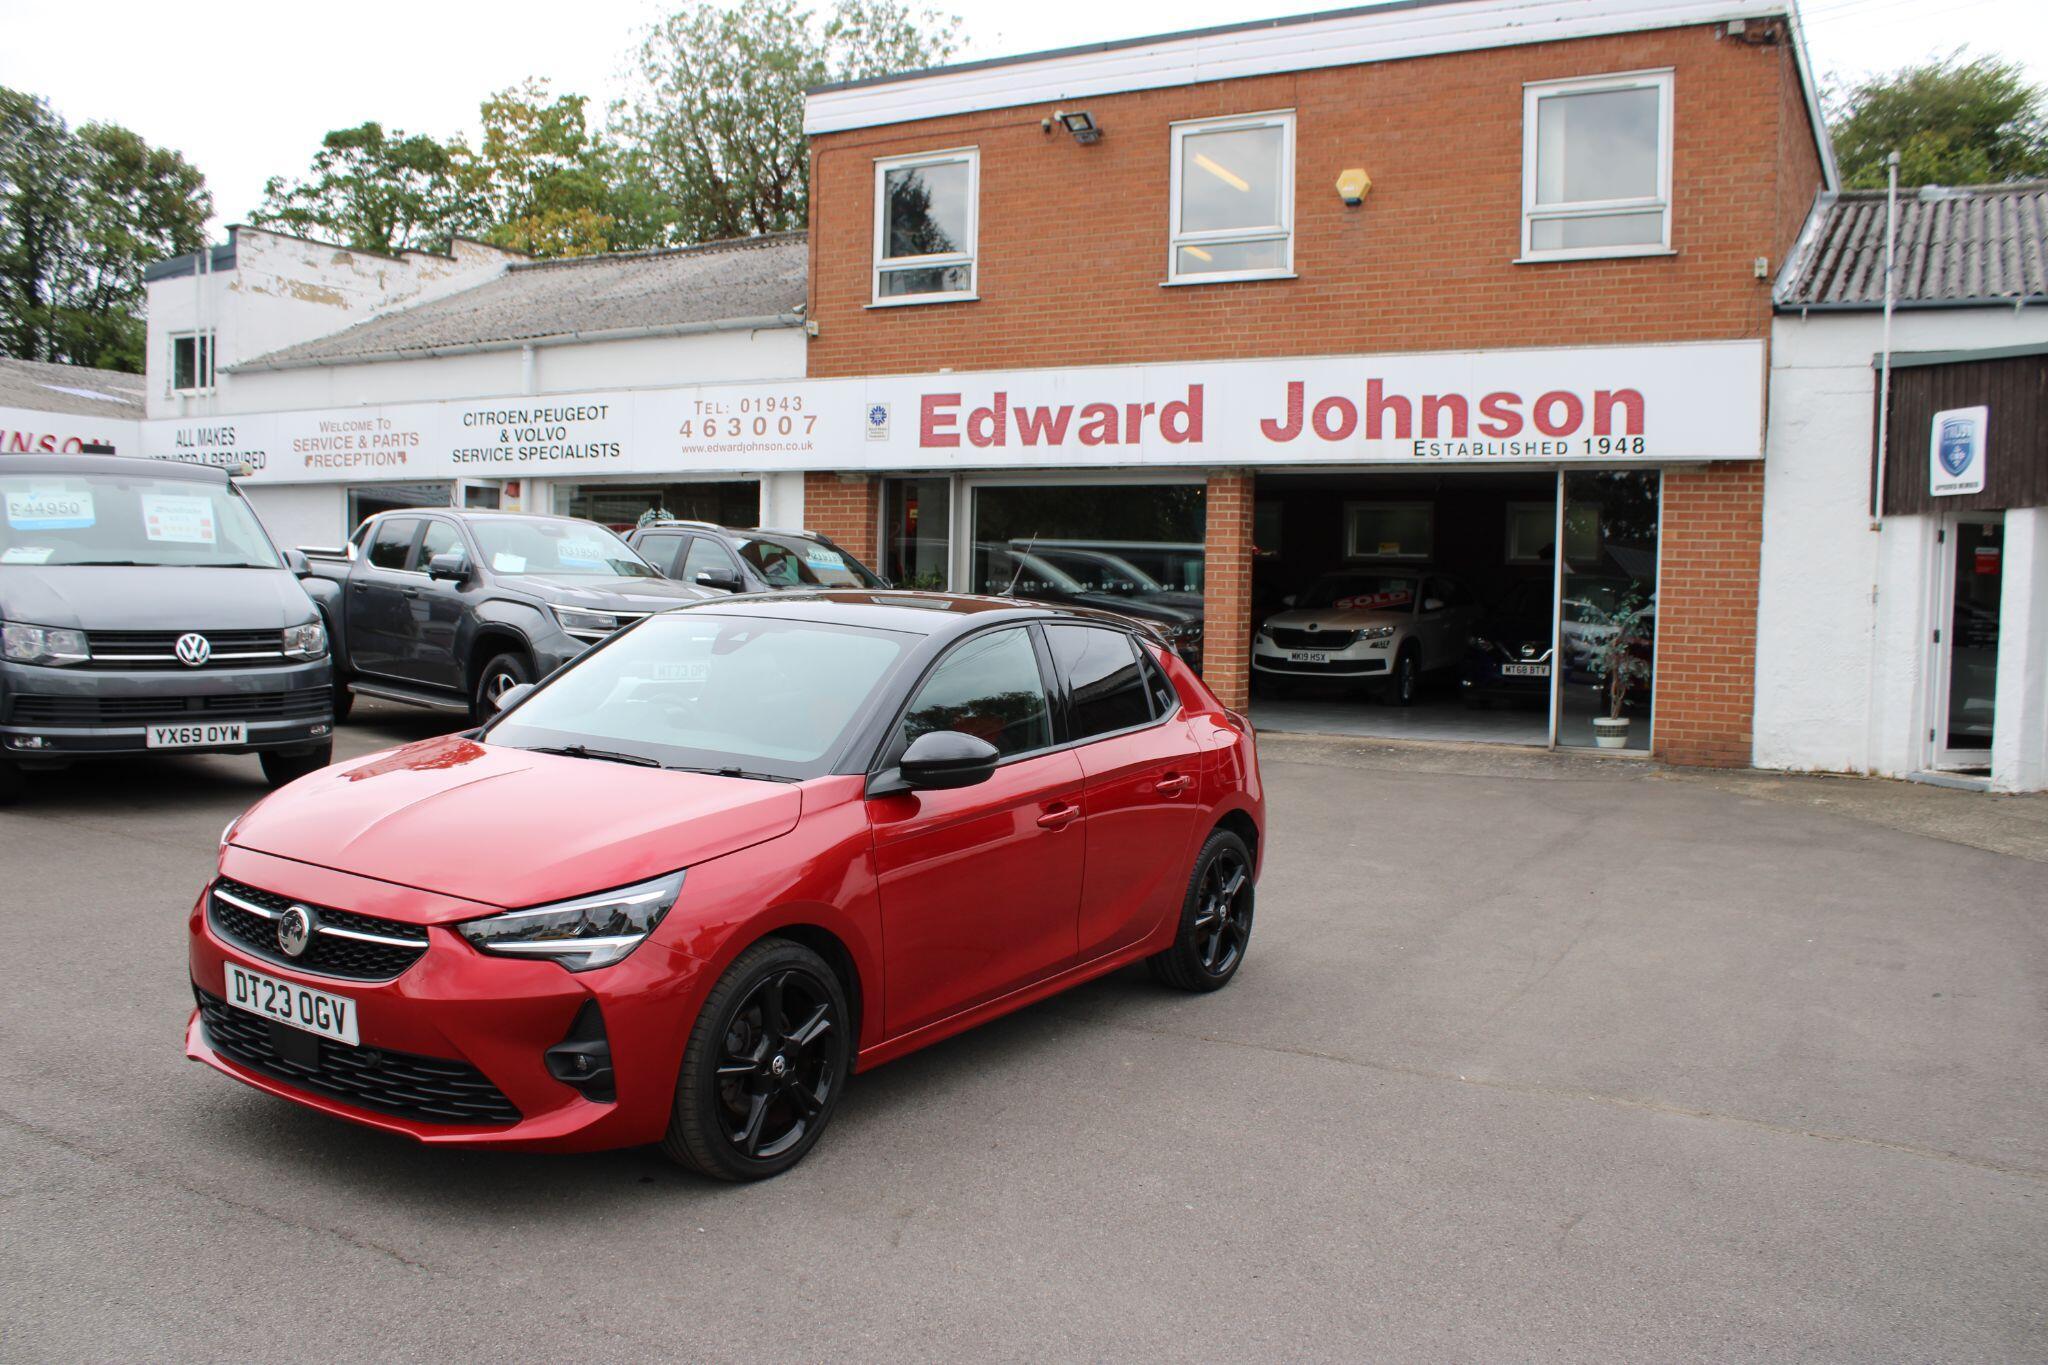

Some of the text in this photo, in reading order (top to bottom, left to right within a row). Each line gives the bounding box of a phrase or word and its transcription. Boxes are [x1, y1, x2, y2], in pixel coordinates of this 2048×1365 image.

[740, 396, 803, 414] 01943
[919, 377, 1645, 448] Edward Johnson
[500, 426, 567, 443] & VOLVO
[679, 415, 818, 438] 463007
[176, 426, 235, 448] ALL MAKES
[293, 432, 420, 452] SERVICE & PARTS
[682, 440, 814, 454] www.edwardjohnson.co.uk
[1414, 437, 1645, 457] ESTABLISHED 1948
[314, 451, 397, 468] RECEPTION
[452, 443, 621, 463] SERVICE SPECIALISTS
[1336, 590, 1407, 609] SOLD
[156, 725, 240, 744] YX69 OYW
[234, 969, 345, 1035] DT23 OGV
